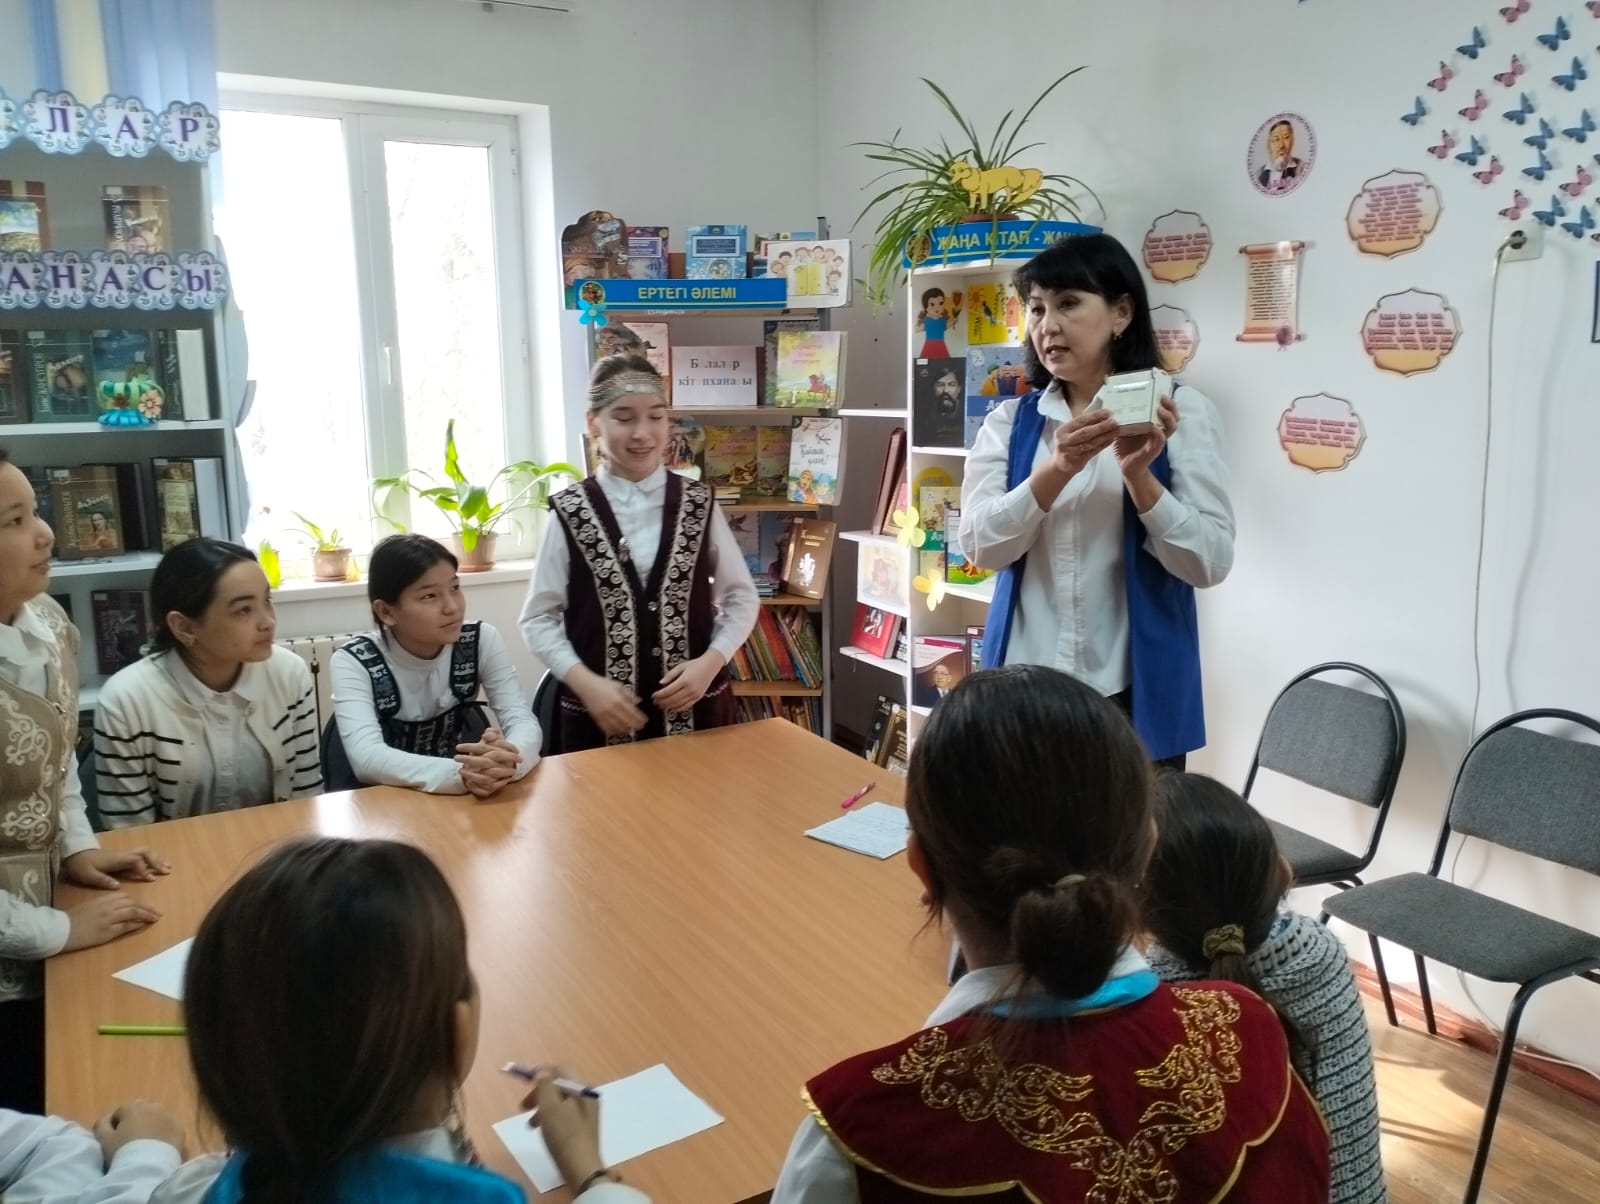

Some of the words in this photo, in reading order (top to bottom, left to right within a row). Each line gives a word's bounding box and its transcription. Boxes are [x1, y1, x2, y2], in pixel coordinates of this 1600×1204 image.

[937, 233, 981, 250] ЖАҢА
[985, 230, 1030, 246] КТАП
[638, 287, 687, 299] ЕРТЕГІ
[691, 287, 737, 299] ӘЛЕМІ
[690, 358, 740, 370] Блалр
[679, 375, 752, 386] кітпханаы
